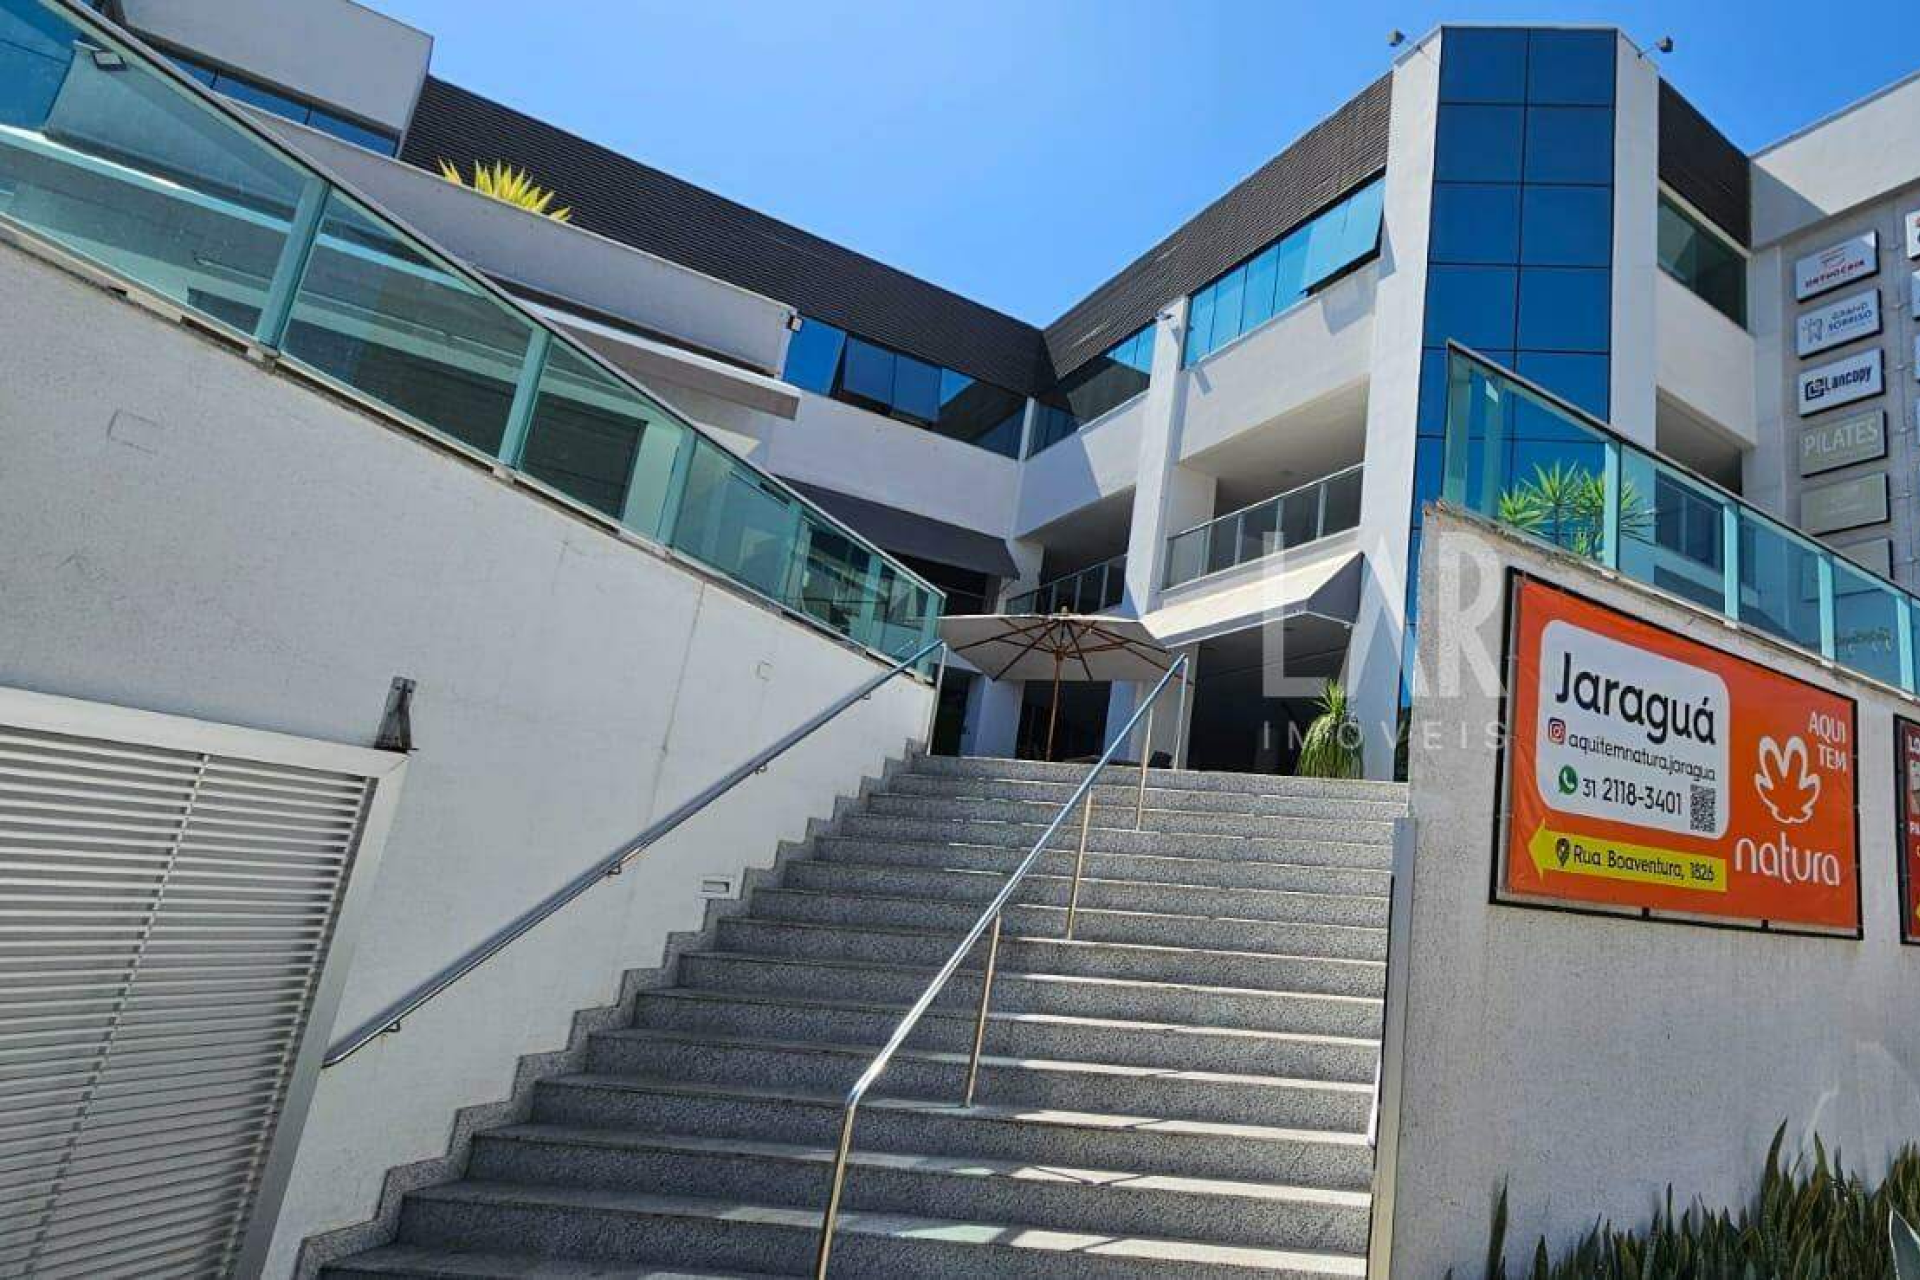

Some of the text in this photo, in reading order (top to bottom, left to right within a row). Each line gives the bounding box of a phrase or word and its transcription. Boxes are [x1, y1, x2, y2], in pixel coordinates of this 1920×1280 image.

[1824, 364, 1873, 391] Lancopy
[1803, 418, 1878, 457] PILATES
[1555, 651, 1717, 744] Jaraguá
[1808, 711, 1847, 743] AQUI
[1818, 743, 1847, 772] TEM
[1582, 777, 1683, 815] 31 2118-3401
[1573, 844, 1601, 866] Rua
[1607, 849, 1686, 881] Boaventura,
[1734, 831, 1841, 887] natura
